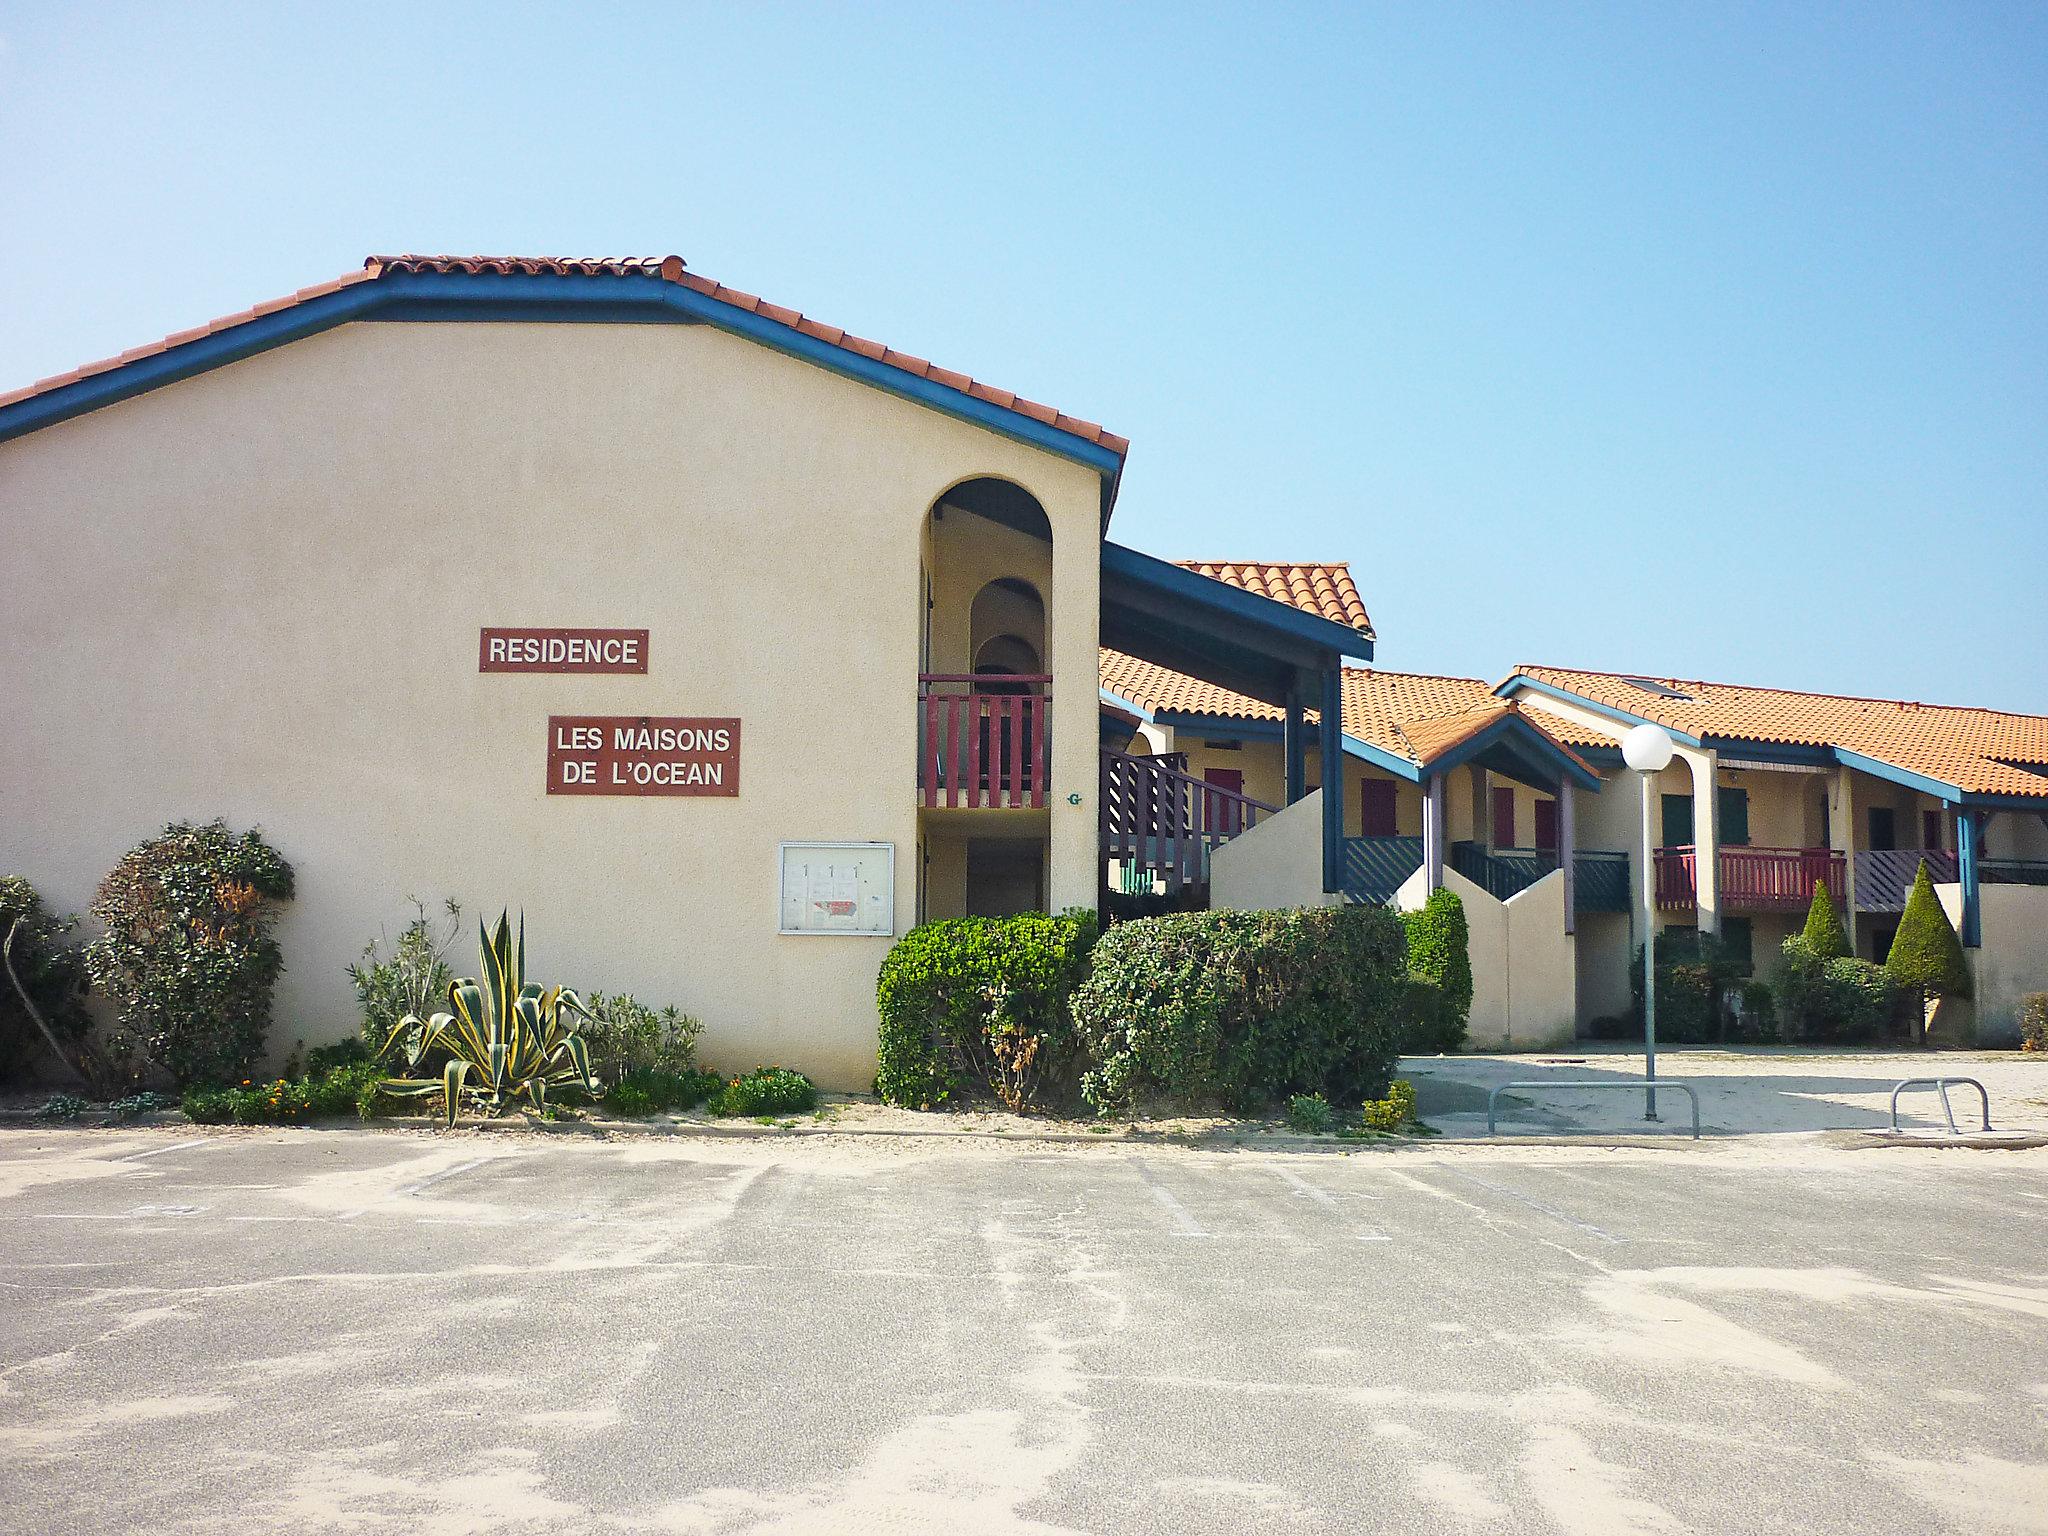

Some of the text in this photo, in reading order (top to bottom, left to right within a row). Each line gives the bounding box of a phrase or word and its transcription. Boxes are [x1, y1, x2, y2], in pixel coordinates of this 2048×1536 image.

[489, 638, 638, 664] RESIDENCE
[557, 727, 730, 752] LES MAISONS
[563, 761, 723, 785] DE L'OCEAN
